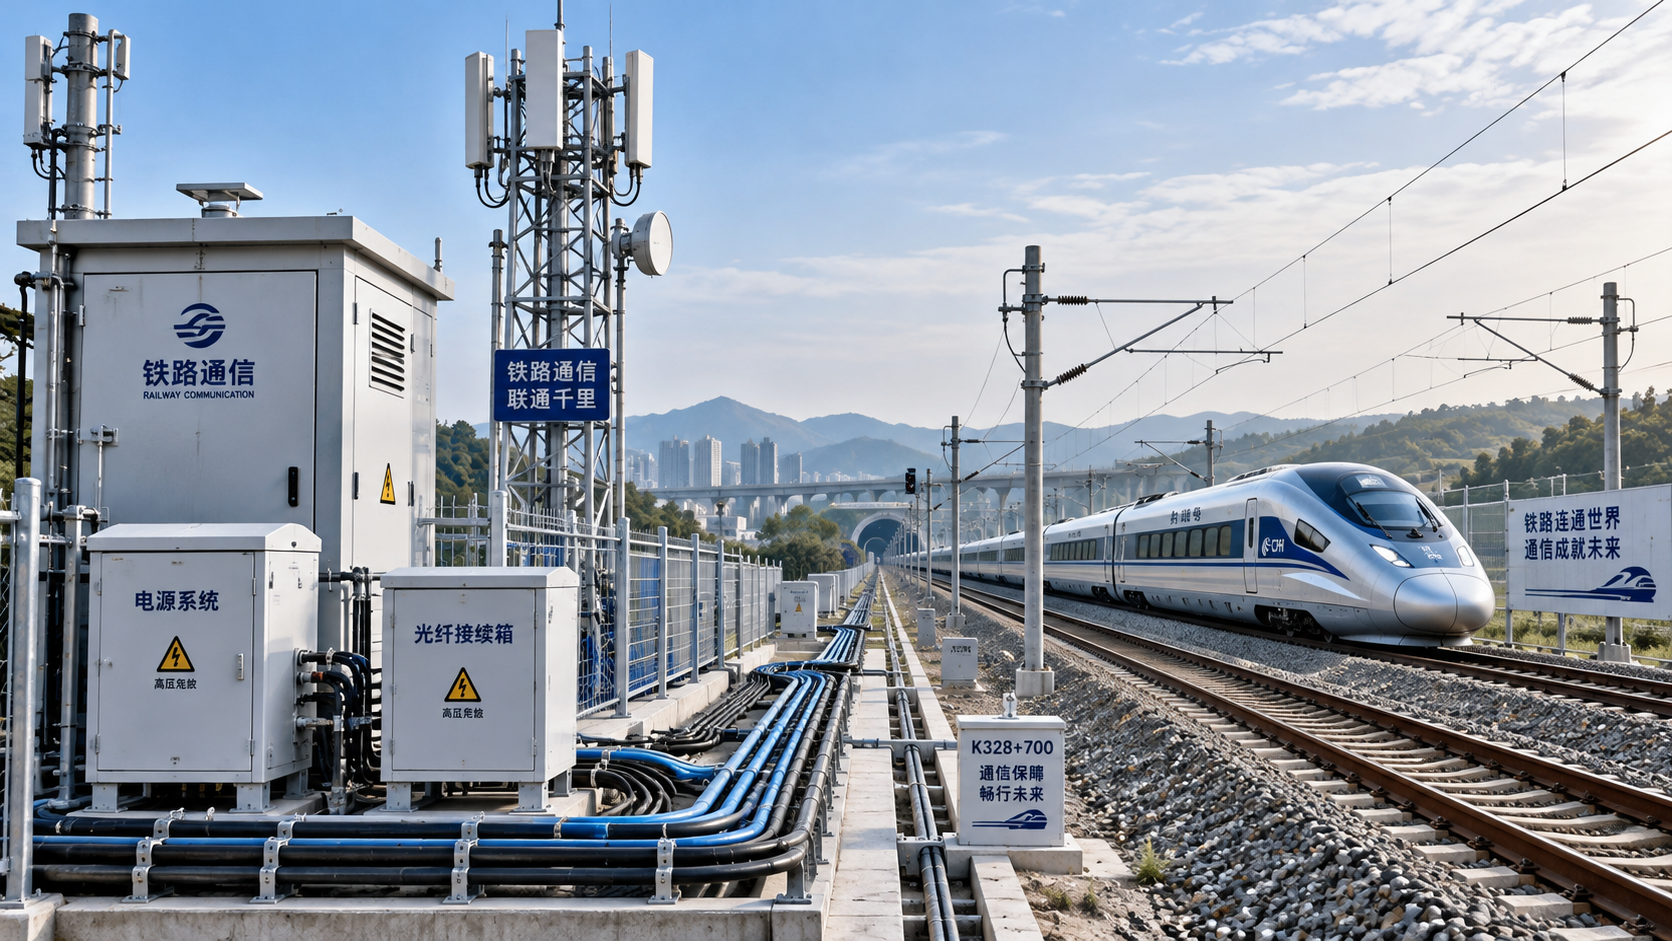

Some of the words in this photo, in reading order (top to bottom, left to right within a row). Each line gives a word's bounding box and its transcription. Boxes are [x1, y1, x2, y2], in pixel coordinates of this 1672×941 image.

[143, 359, 255, 386] 铁路通信
[507, 360, 597, 382] 铁路通信
[143, 391, 181, 399] RAILWAY
[183, 390, 255, 399] COMMUNICATION
[507, 388, 597, 410] 联通千里
[1524, 506, 1620, 533] 铁路连通世界
[1524, 536, 1621, 560] 通信成就未来
[135, 590, 219, 611] 电源系统
[414, 623, 514, 644] 光纤接续箱
[972, 740, 1054, 755] K328+700
[979, 785, 1044, 802] 畅行未来
